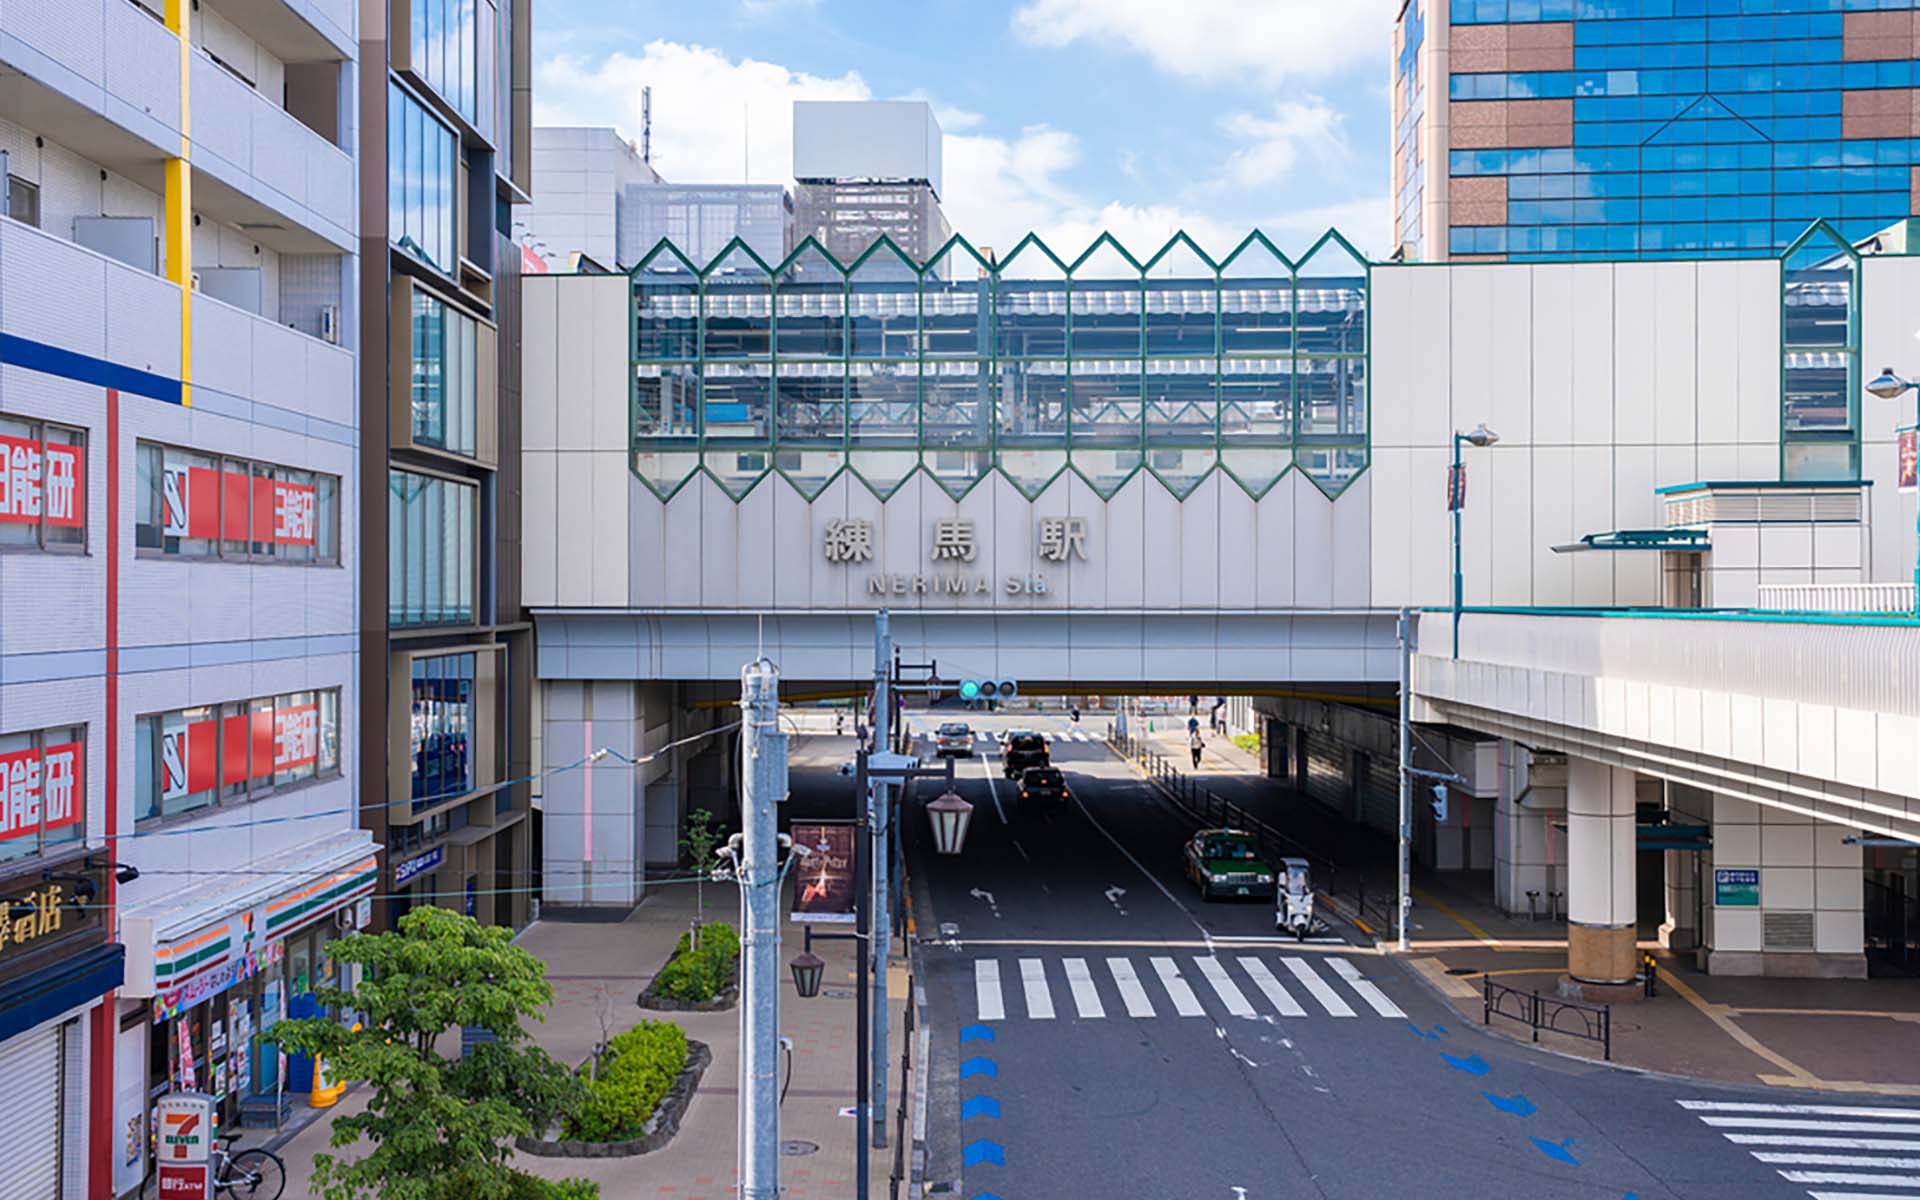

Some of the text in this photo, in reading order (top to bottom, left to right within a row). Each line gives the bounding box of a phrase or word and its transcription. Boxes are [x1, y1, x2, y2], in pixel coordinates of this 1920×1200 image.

[824, 517, 1088, 563] 練馬駅
[869, 575, 991, 594] NERIMA
